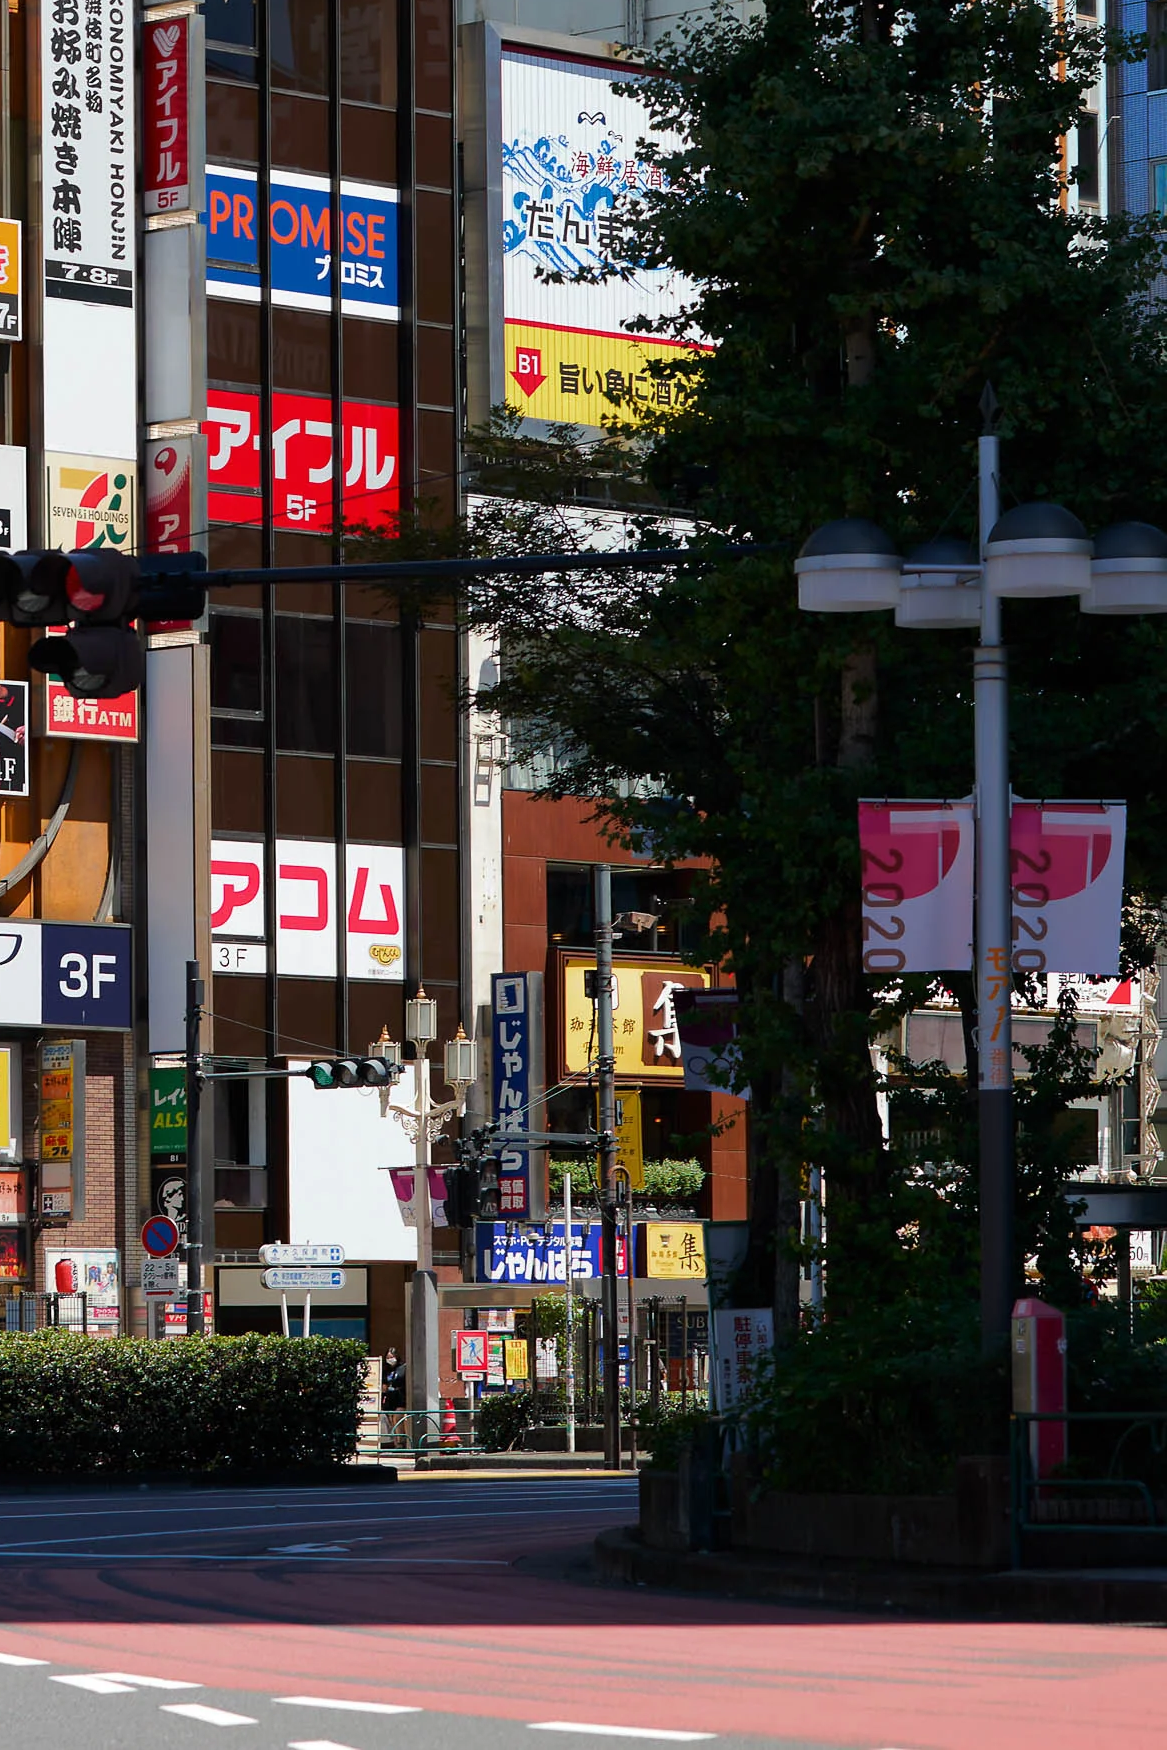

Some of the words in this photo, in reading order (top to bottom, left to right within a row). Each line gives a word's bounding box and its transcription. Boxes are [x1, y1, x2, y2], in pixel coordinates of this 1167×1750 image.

[155, 60, 182, 184] アイフル
[571, 150, 665, 188] 海鮮居酒
[109, 162, 126, 261] HONJIN
[156, 191, 180, 209] 5F
[209, 189, 387, 260] PROMISE
[314, 254, 386, 289] プロミス
[518, 353, 539, 376] B1
[206, 404, 396, 491] アイフル
[88, 509, 129, 525] HOLDINGS
[285, 494, 318, 522] 5F
[211, 859, 400, 936] アコム
[862, 848, 907, 974] 2020
[1010, 848, 1052, 974] 2020
[58, 951, 118, 1000] 3F
[219, 947, 248, 968] 3F
[45, 1135, 68, 1147] 麻雀
[51, 1146, 70, 1156] ブル
[500, 1179, 525, 1194] 高価
[501, 1194, 525, 1211] 買取
[678, 1231, 707, 1273] 集
